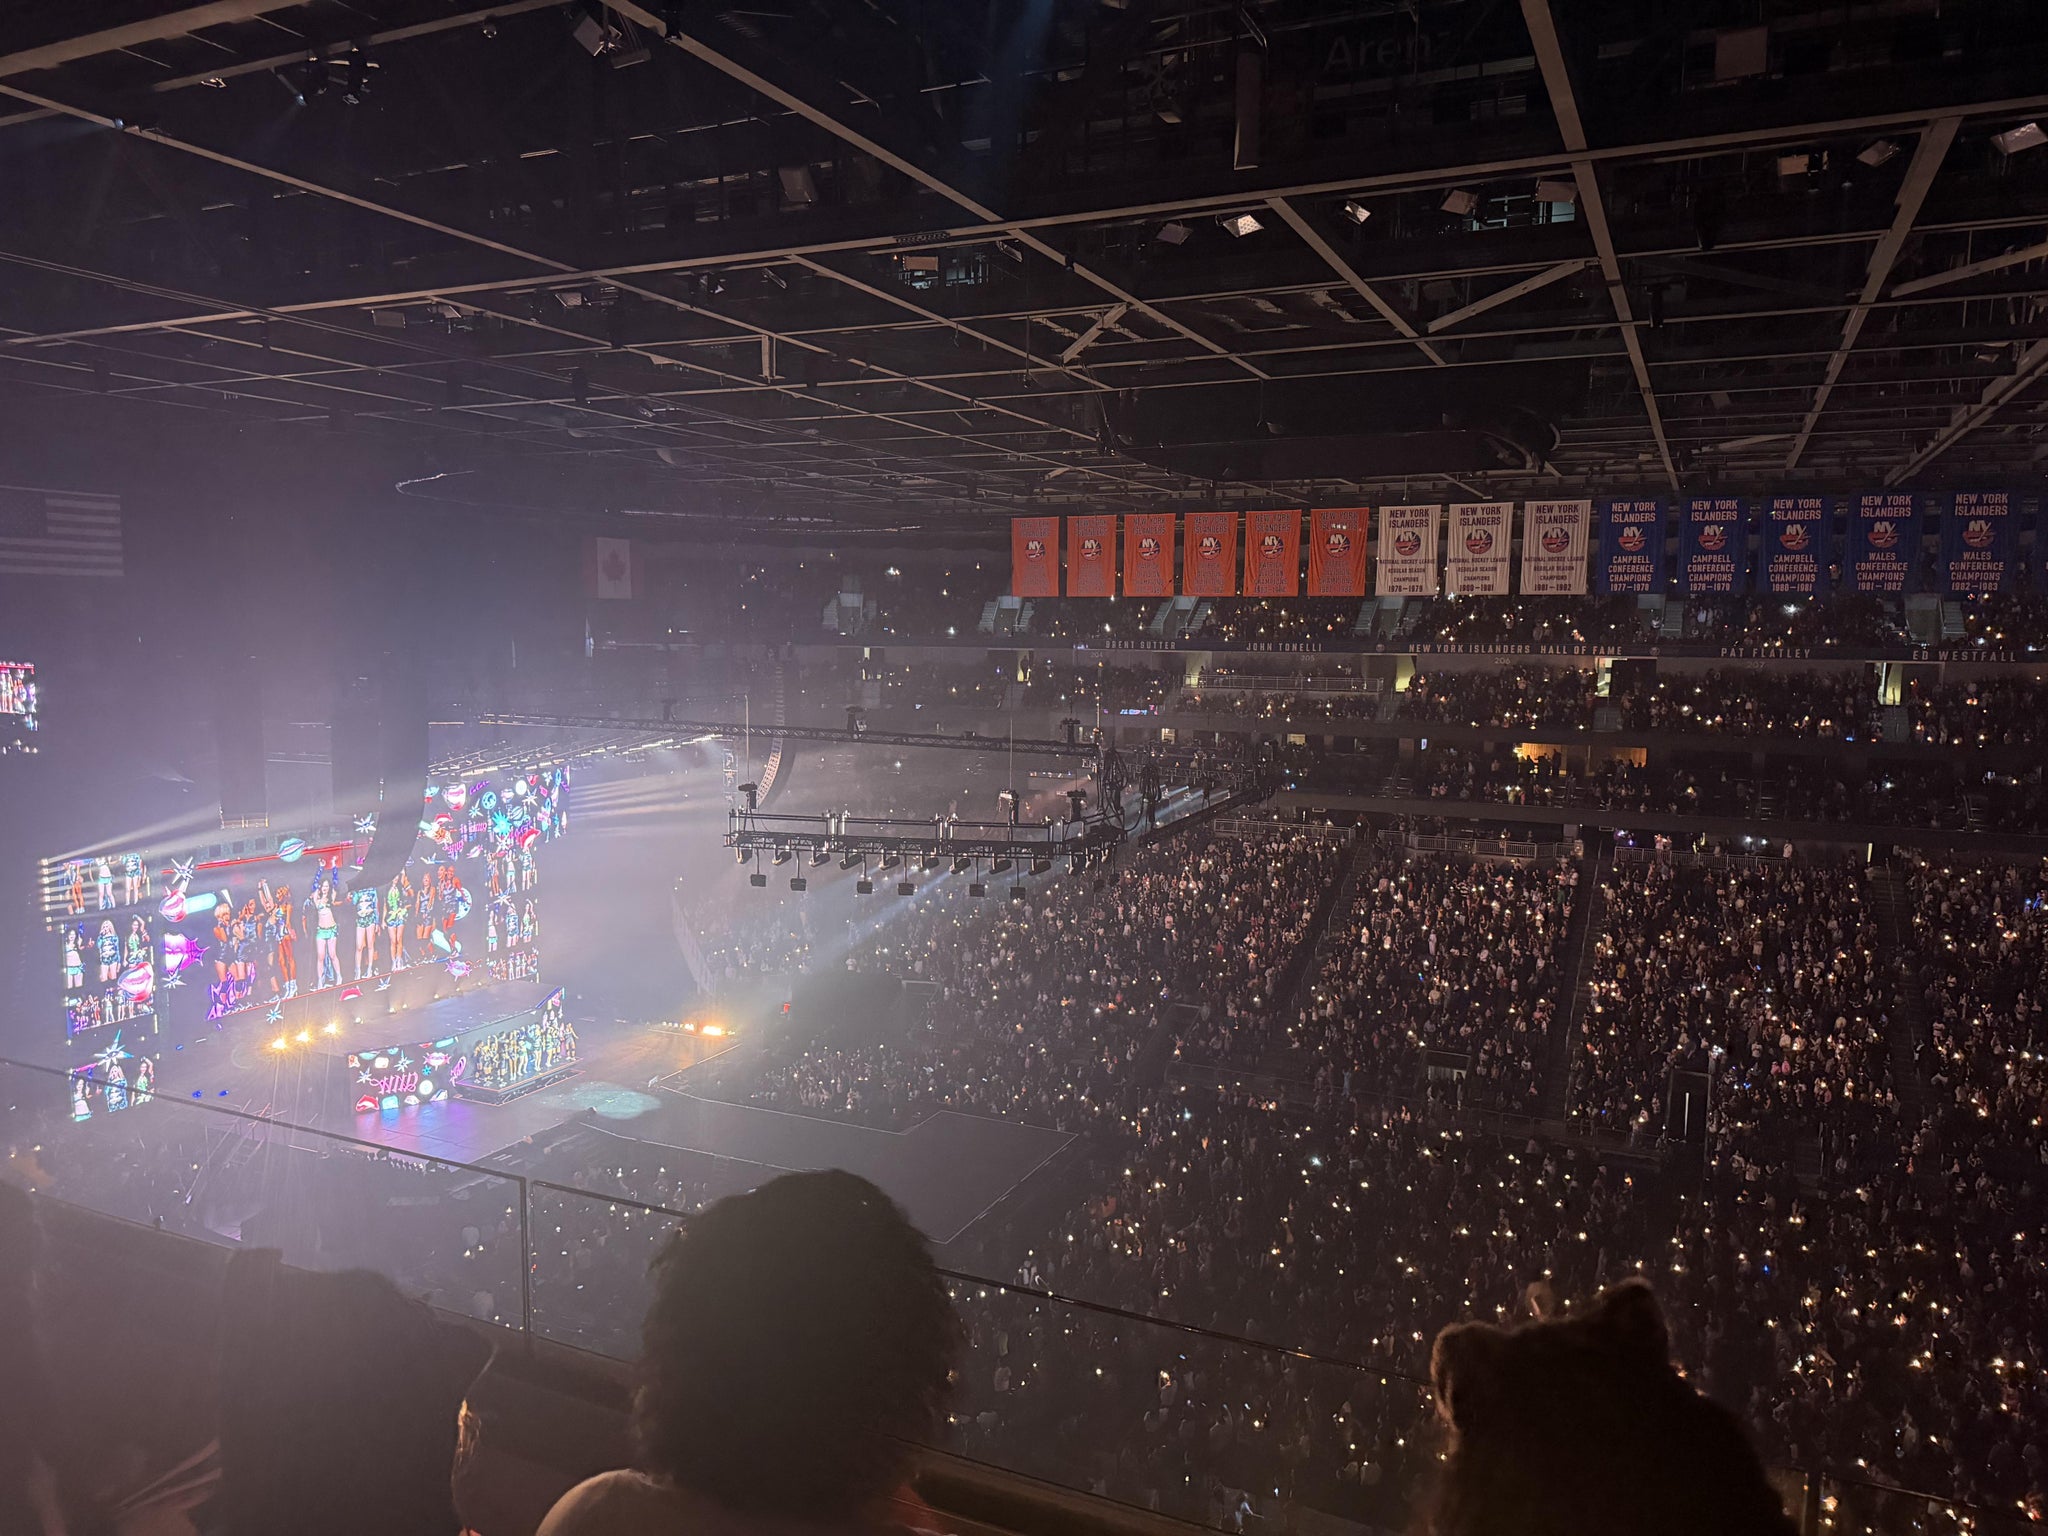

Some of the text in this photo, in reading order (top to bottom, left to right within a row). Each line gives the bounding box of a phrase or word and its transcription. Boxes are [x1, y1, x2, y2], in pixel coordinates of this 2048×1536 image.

[1861, 495, 1912, 506] NEW YORK
[1956, 493, 2008, 504] NEW YORK
[1536, 504, 1579, 513] NEW YORK
[1612, 502, 1656, 511] NEW YORK
[1692, 499, 1738, 510] NEW YORK
[1773, 499, 1822, 509] NEW YORK
[1389, 508, 1430, 518] NEW YORK
[1460, 506, 1501, 516] NEW YORK
[1772, 510, 1821, 520] ISLANDERS
[1860, 507, 1911, 517] ISLANDERS
[1955, 505, 2008, 516] ISLANDERS
[1459, 516, 1501, 526] ISLANDERS
[1536, 514, 1579, 524] ISLANDERS
[1611, 512, 1656, 523] ISLANDERS
[1691, 511, 1738, 521] ISLANDERS
[1389, 518, 1430, 528] ISLANDERS
[1612, 556, 1651, 564] CAMPBELL
[1692, 555, 1731, 563] CAMPBELL
[1773, 554, 1814, 563] CAMPBELL
[1869, 552, 1896, 561] WALES
[1963, 552, 1992, 560] WALES
[1608, 565, 1654, 573] CONFERENCE
[1687, 563, 1735, 572] CONFERENCE
[1768, 563, 1818, 572] CONFERENCE
[1855, 563, 1908, 571] CONFERENCE
[1949, 562, 2004, 570] CONFERENCE
[1609, 574, 1652, 582] CHAMPIONS
[1688, 573, 1733, 582] CHAMPIONS
[1770, 573, 1816, 582] CHAMPIONS
[1857, 572, 1905, 580] CHAMPIONS
[1951, 571, 2001, 580] CHAMPIONS
[1105, 640, 1176, 650] BRENT SUTTER
[1246, 642, 1322, 652] JOHN TONELLI
[1409, 644, 1622, 655] NEW YORK ISLANDERS HALL OF FAME
[1721, 648, 1811, 658] PAT FLATLEY
[1912, 650, 2017, 662] ED WESTFALL
[1494, 657, 1511, 665] 206
